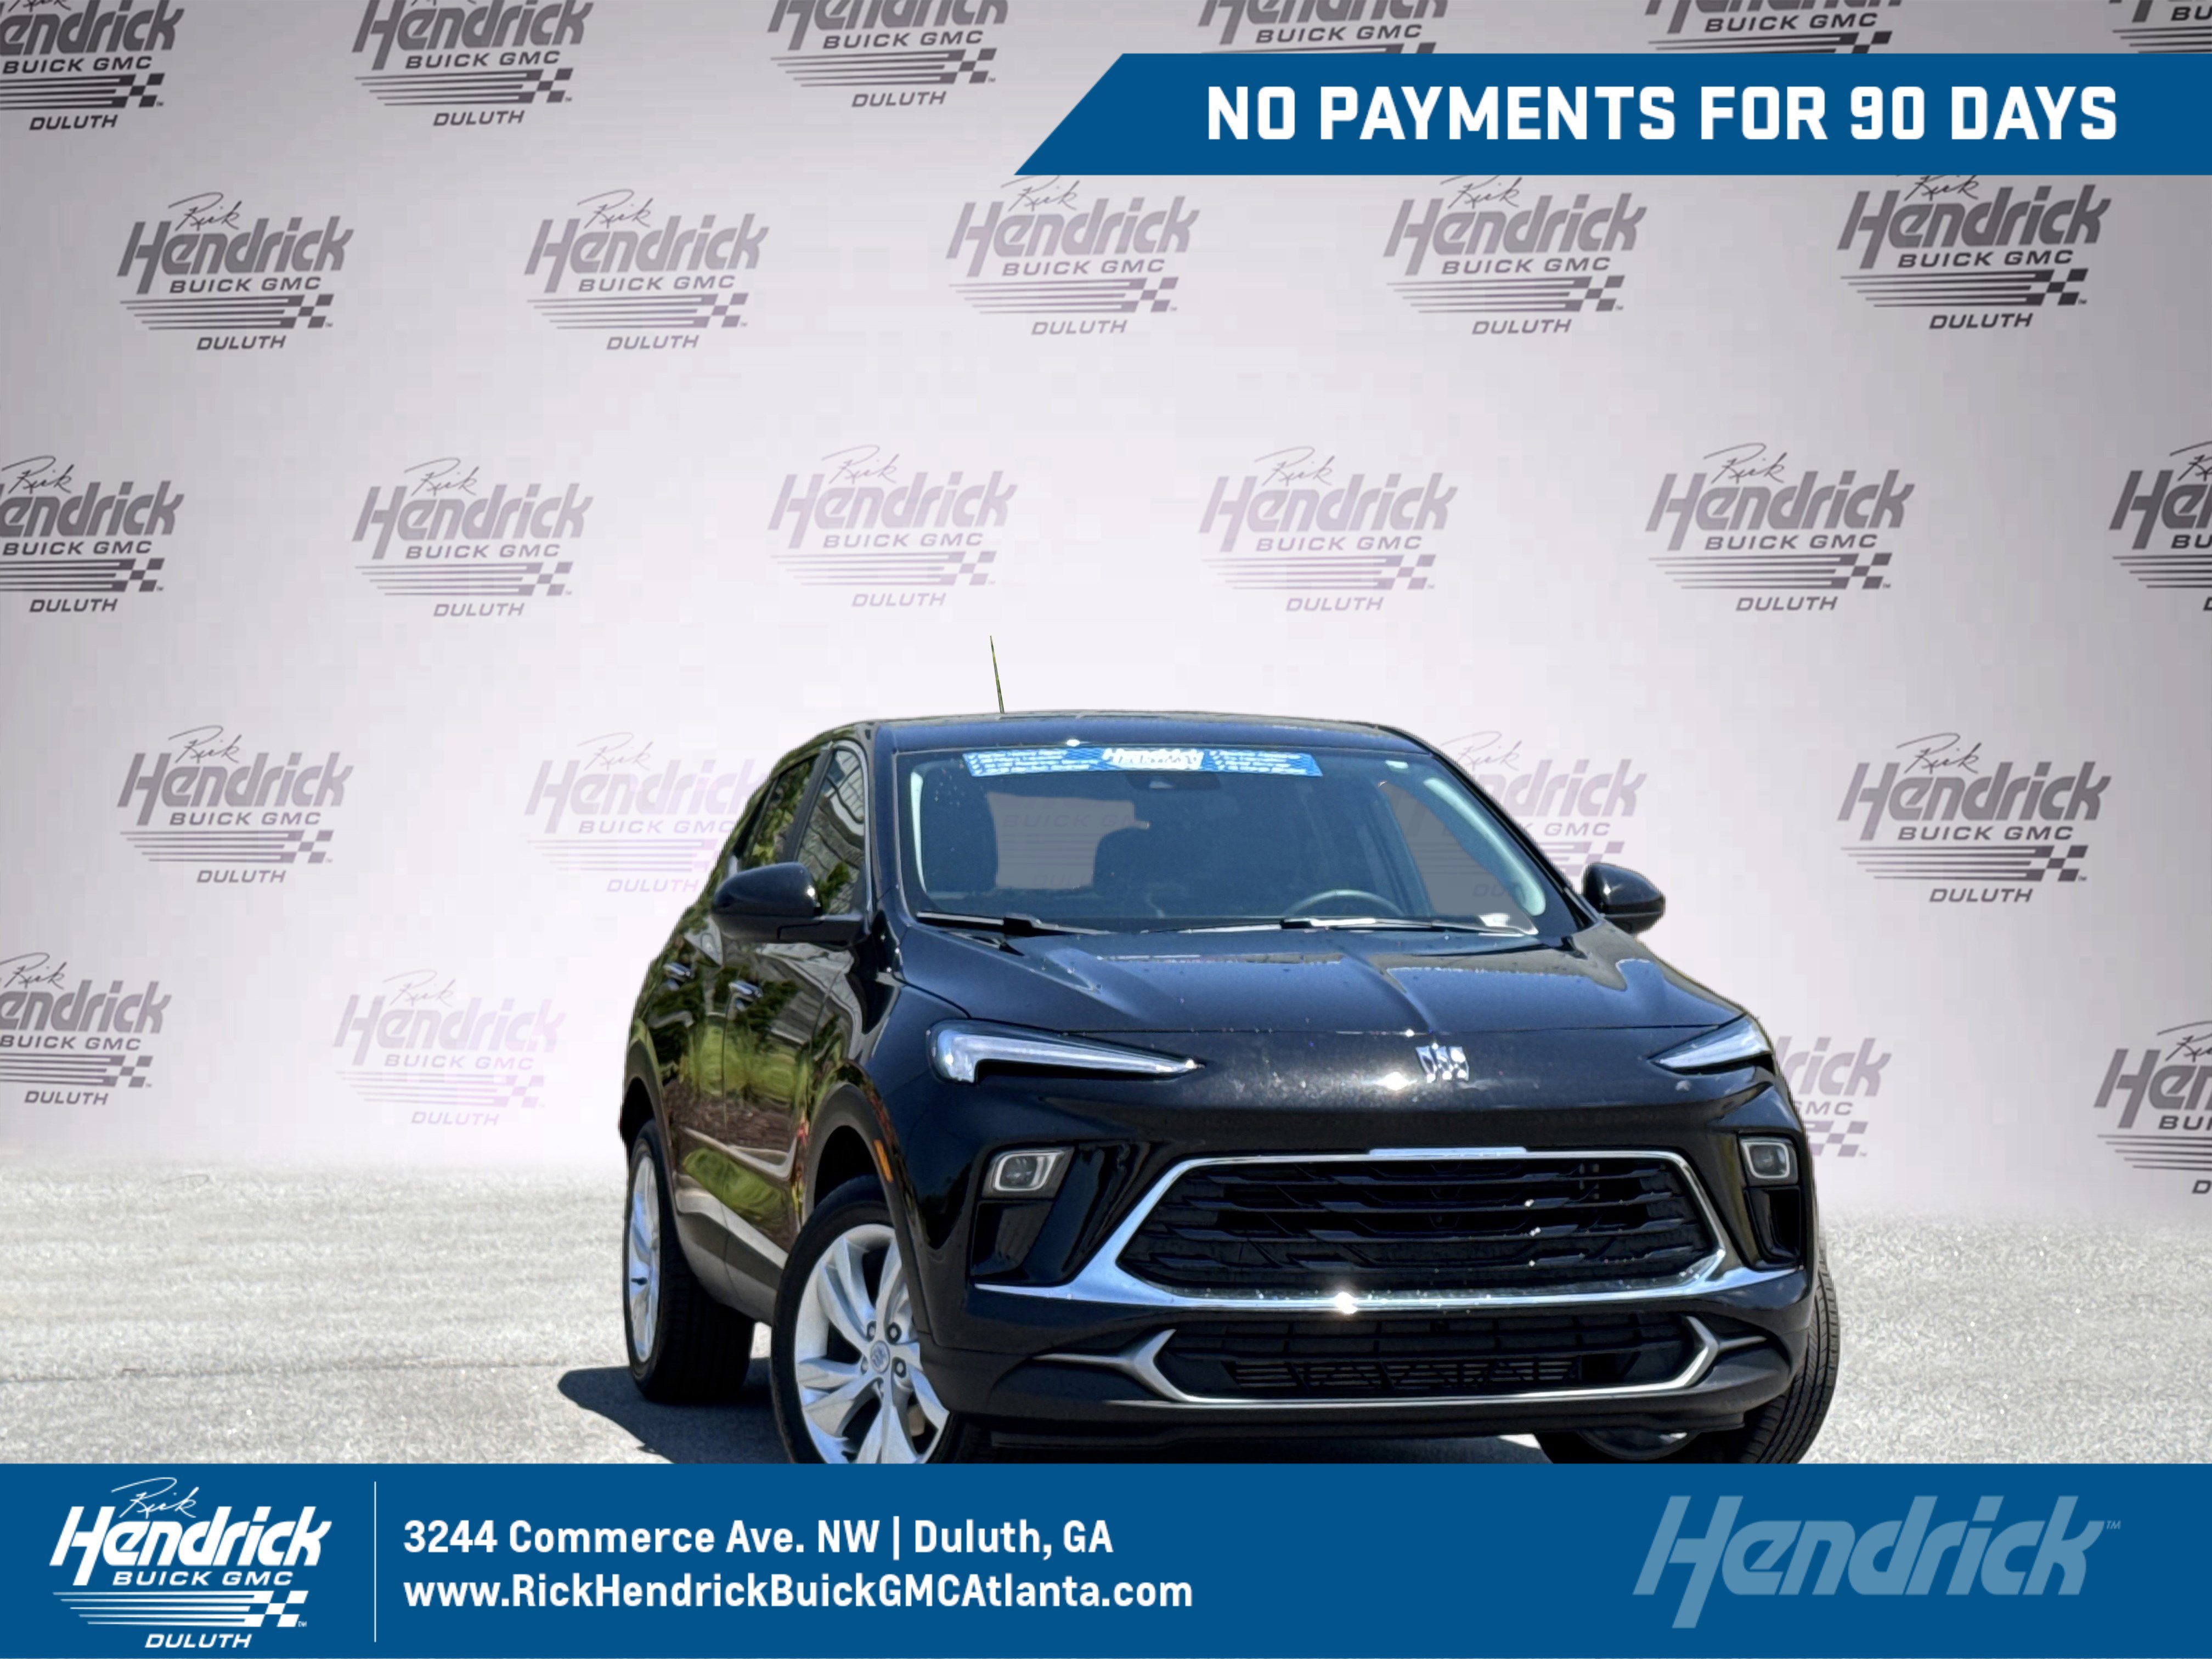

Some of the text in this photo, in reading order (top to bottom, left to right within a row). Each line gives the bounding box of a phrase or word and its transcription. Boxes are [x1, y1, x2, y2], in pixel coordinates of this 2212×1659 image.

[0, 0, 184, 57] endrick
[1705, 15, 1799, 32] BUICK
[1809, 13, 1877, 29] GMC
[352, 0, 594, 70] Hendrick
[823, 30, 983, 49] BUICK GMC
[1256, 24, 1422, 43] BUICK GMC
[3, 56, 152, 74] BUICK GMC
[405, 50, 560, 69] BUICK GMC
[852, 91, 946, 107] DULUTH
[29, 115, 118, 130] DULUTH
[433, 110, 524, 126] DULUTH
[1384, 193, 1647, 275] Hendrick
[1837, 184, 2111, 269] Hendrick
[946, 196, 1200, 278] Hendrick
[117, 216, 354, 295] Hendrick
[524, 213, 769, 294] Hendrick
[1898, 250, 2073, 268] BUICK GMC
[1002, 259, 1165, 276] BUICK GMC
[1442, 257, 1610, 274] BUICK GMC
[170, 276, 321, 293] BUICK GMC
[579, 275, 735, 292] BUICK GMC
[1031, 320, 1127, 335] DULUTH
[1472, 319, 1572, 334] DULUTH
[1929, 313, 2033, 329] DULUTH
[197, 335, 286, 350] DULUTH
[607, 335, 699, 350] DULUTH
[0, 481, 184, 538] endrick
[767, 470, 1018, 549] Hendrick
[1199, 472, 1458, 552] Hendrick
[1646, 469, 1915, 551] Hendrick
[352, 483, 593, 560] Hendrick
[3, 541, 152, 556] BUICK GMC
[823, 533, 983, 548] BUICK GMC
[1256, 536, 1421, 551] BUICK GMC
[1705, 534, 1877, 550] BUICK GMC
[406, 544, 560, 559] BUICK GMC
[30, 599, 117, 612] DULUTH
[851, 592, 946, 607] DULUTH
[1286, 597, 1384, 611] DULUTH
[1736, 596, 1838, 611] DULUTH
[433, 603, 524, 617] DULUTH
[117, 752, 353, 826] Hendrick
[1838, 761, 2111, 840] Hendrick
[170, 812, 320, 825] BUICK GMC
[578, 821, 663, 834] BUICK
[1545, 822, 1610, 836] GMC
[1898, 826, 2073, 840] BUICK GMC
[197, 870, 286, 883] DULUTH
[606, 879, 699, 893] DULUTH
[1929, 889, 2033, 902] DULUTH
[0, 980, 172, 1034] endrick
[333, 994, 566, 1065] Hendrick
[0, 1035, 140, 1051] BUICK GMC
[384, 1054, 534, 1070] BUICK GMC
[25, 1091, 108, 1105] DULUTH
[411, 1111, 499, 1125] DULUTH
